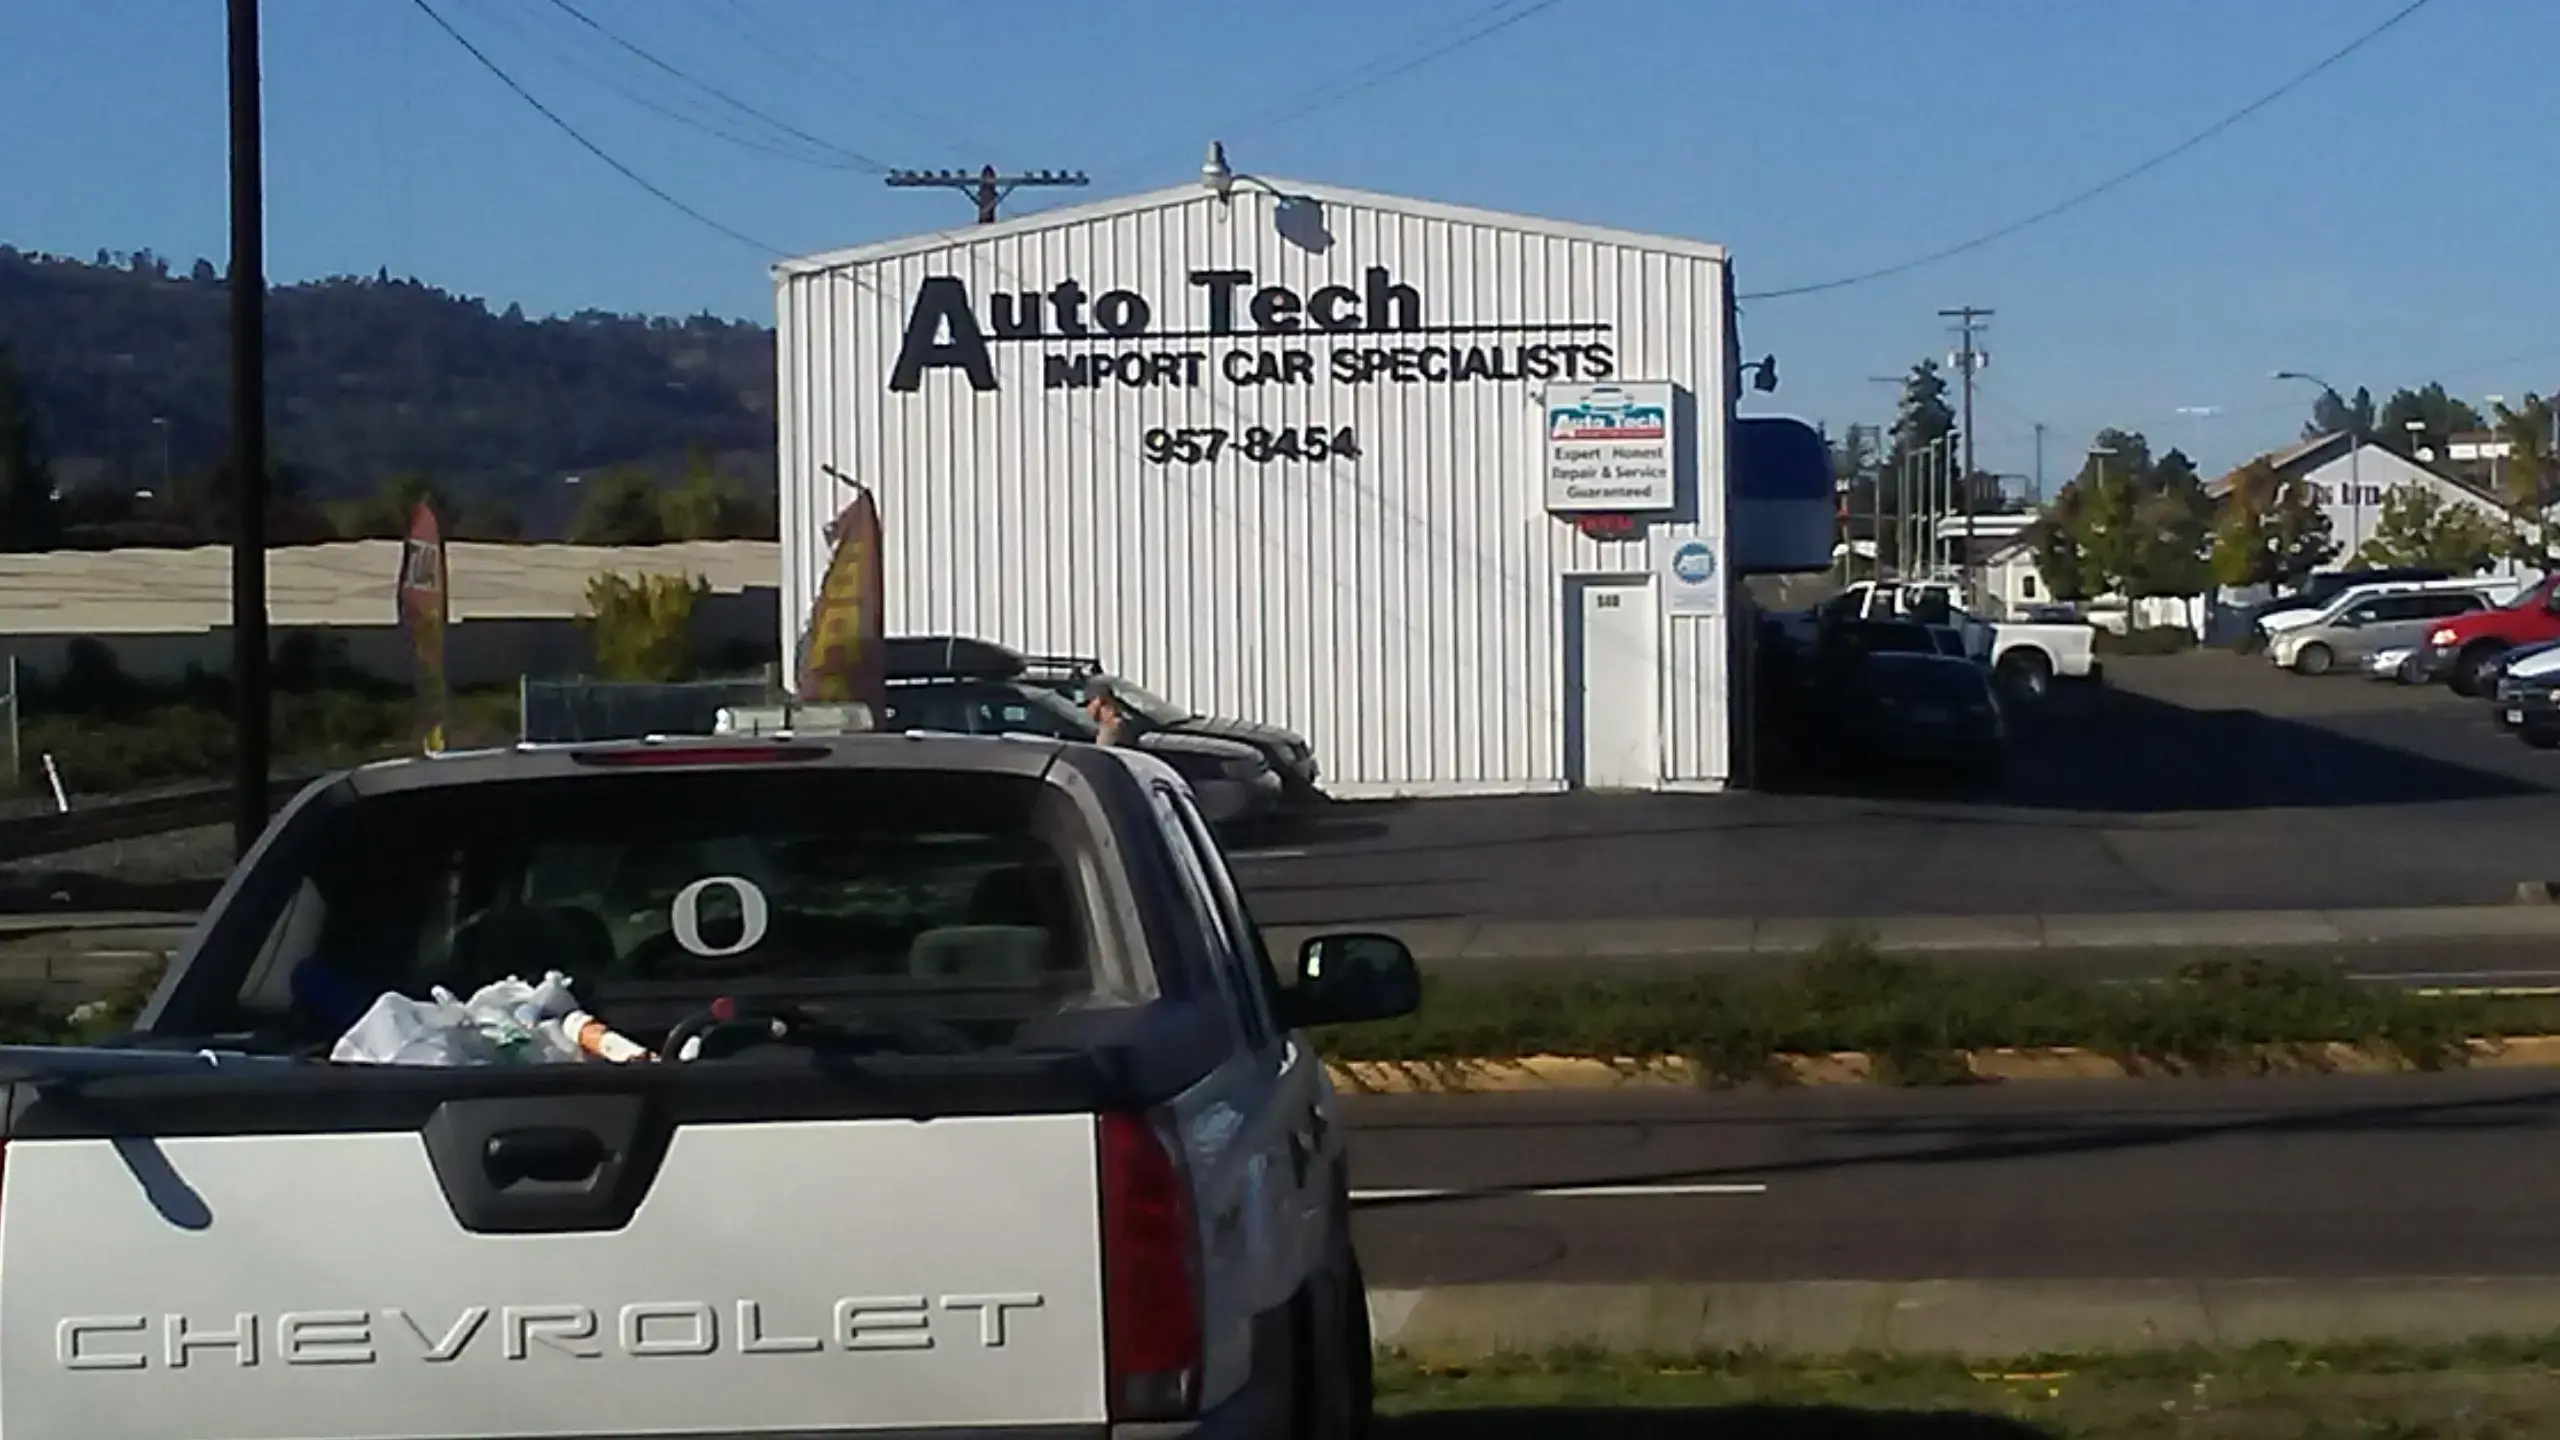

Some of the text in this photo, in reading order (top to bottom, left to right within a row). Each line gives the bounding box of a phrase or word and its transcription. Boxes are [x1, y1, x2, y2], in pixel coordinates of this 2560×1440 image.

[889, 266, 1421, 391] Auto Tech
[1044, 342, 1614, 389] IMPORT CAR SPECIALISTS
[1552, 412, 1605, 438] Auto
[1611, 411, 1662, 428] Tech
[1144, 426, 1362, 465] 957-8454
[1555, 446, 1663, 463] Expert Honest
[1552, 465, 1667, 482] Repair & Service
[1566, 484, 1652, 499] Guaranteed
[55, 1291, 1045, 1370] CHEVROLET
